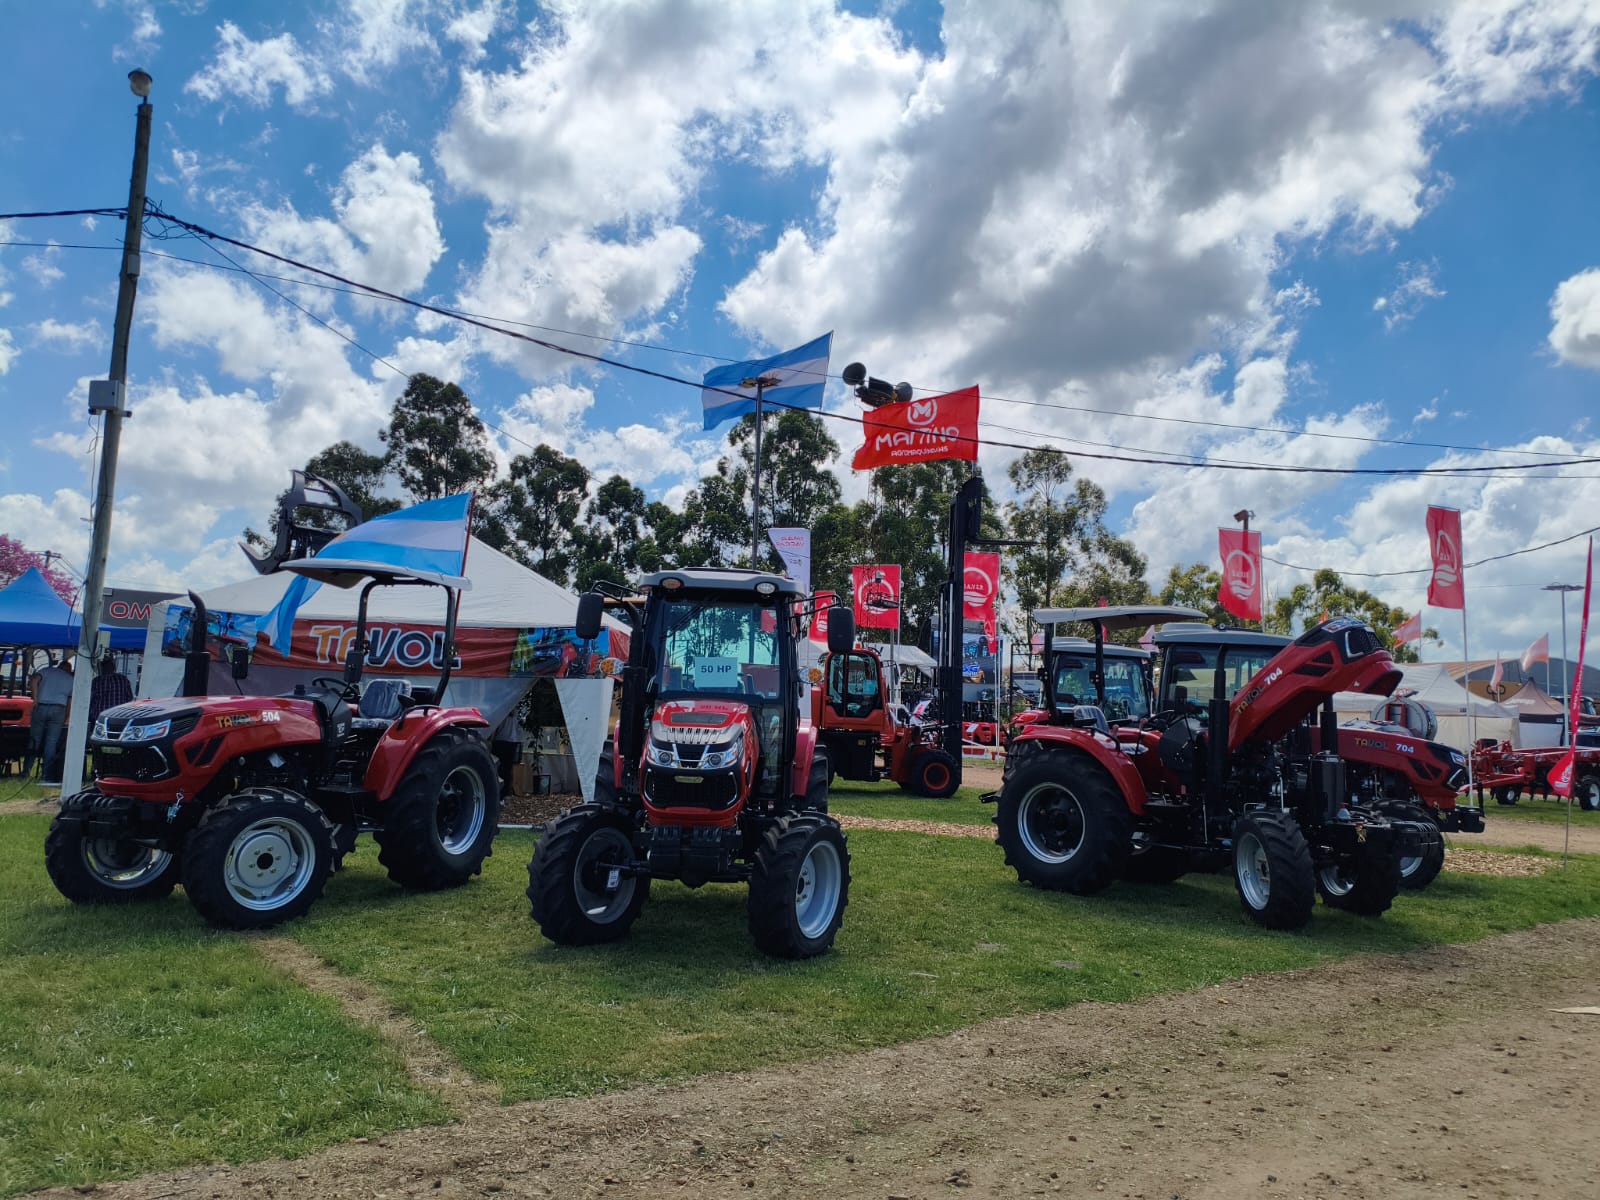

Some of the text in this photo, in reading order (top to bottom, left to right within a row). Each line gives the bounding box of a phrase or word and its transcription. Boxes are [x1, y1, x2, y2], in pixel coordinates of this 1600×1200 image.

[309, 625, 462, 670] TAVOL
[700, 665, 732, 673] 50 HP
[1264, 667, 1283, 686] 704
[262, 711, 280, 722] 504
[1396, 743, 1415, 754] 704
